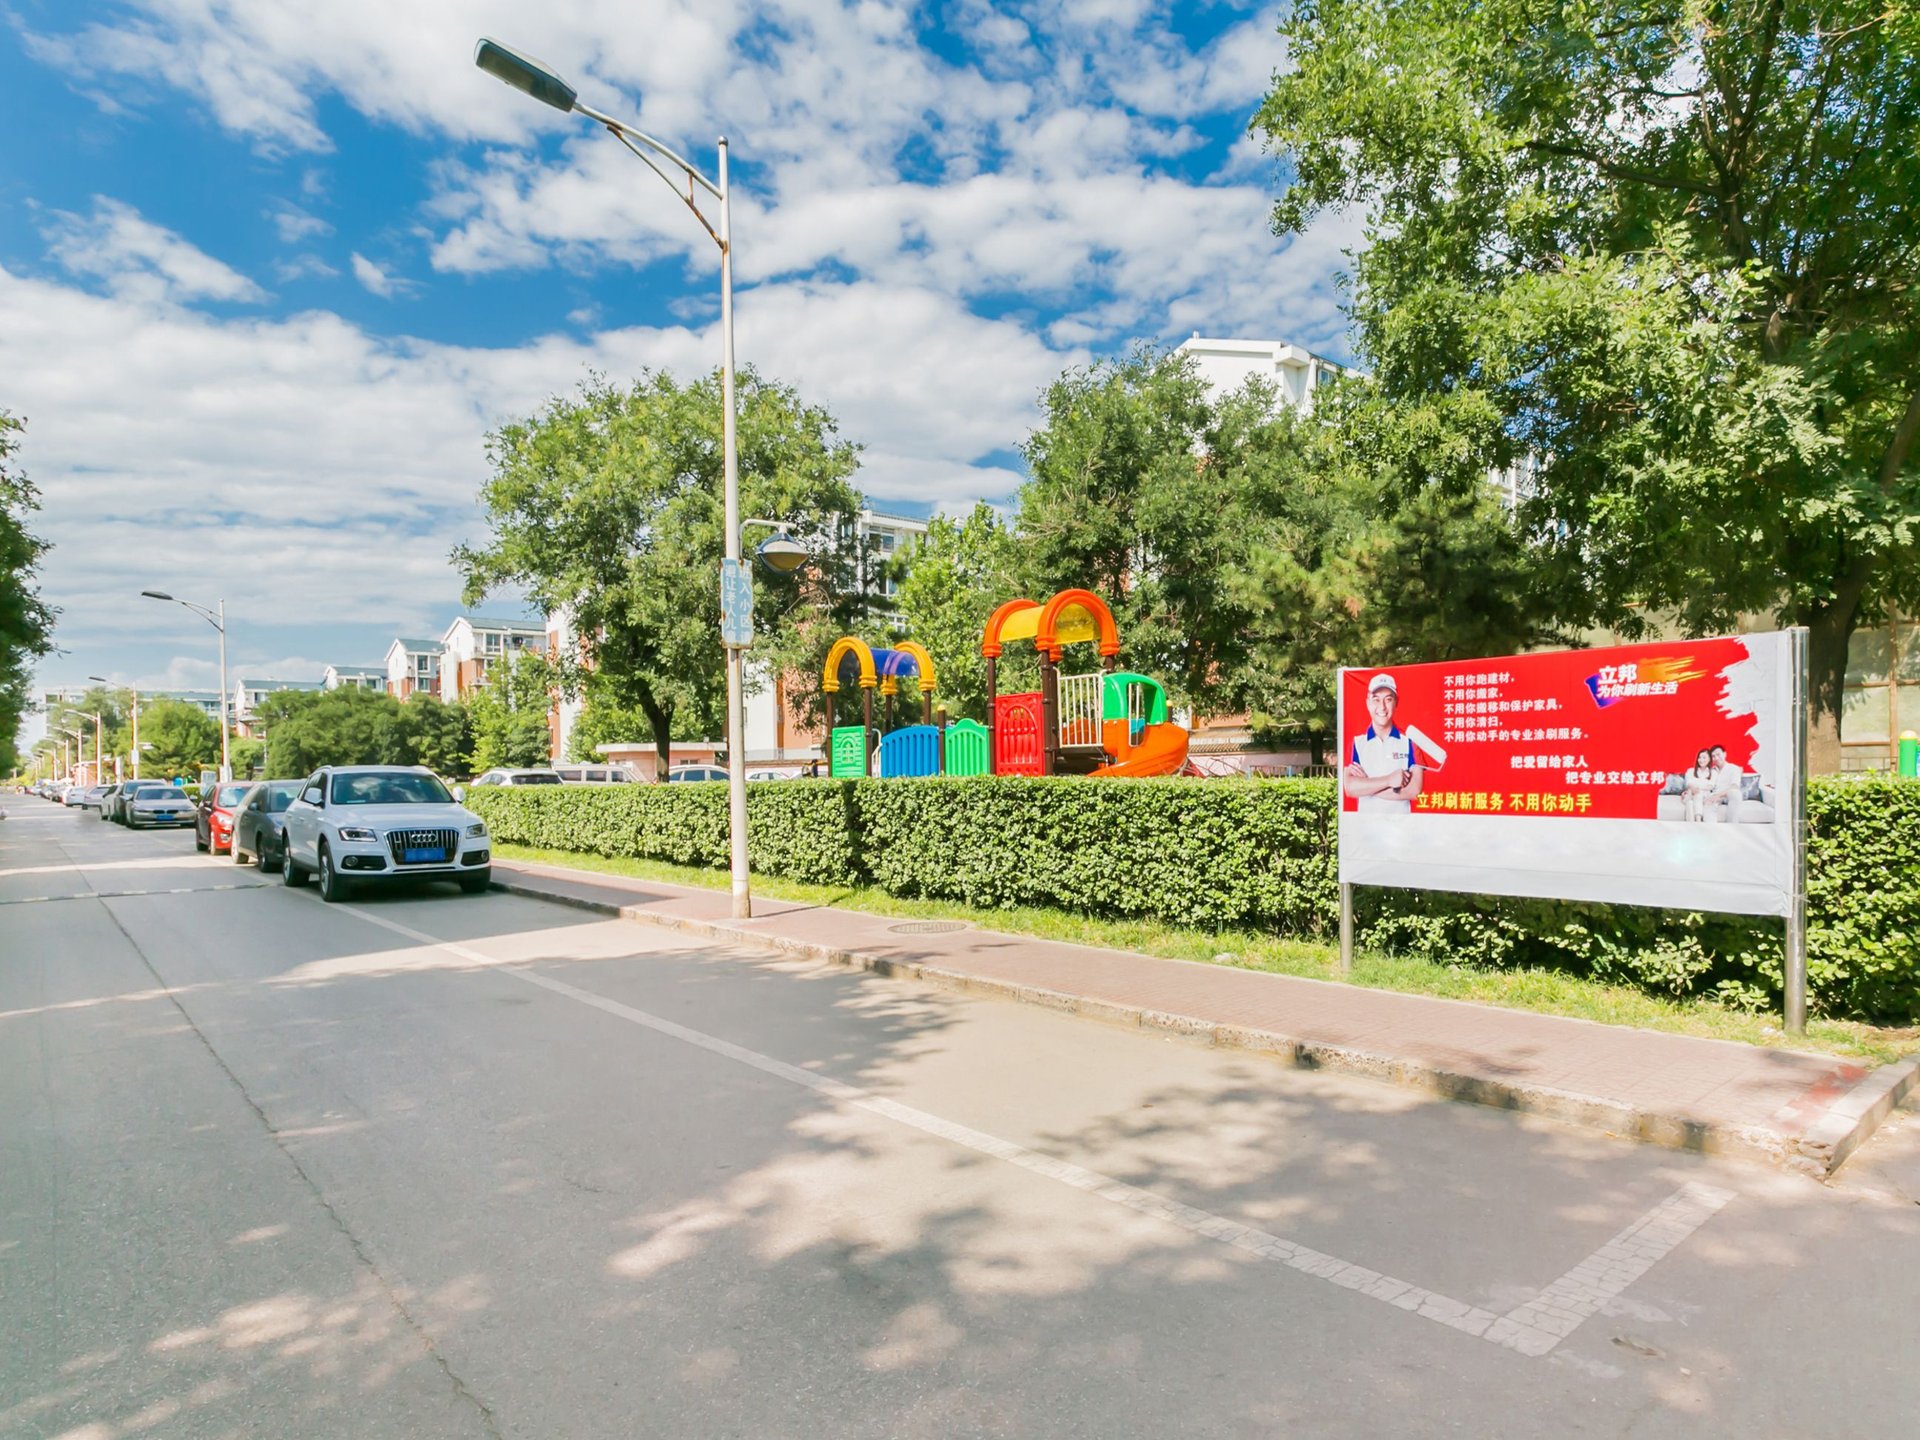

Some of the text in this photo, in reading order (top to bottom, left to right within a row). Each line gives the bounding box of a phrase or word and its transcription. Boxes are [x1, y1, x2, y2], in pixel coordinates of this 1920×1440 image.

[725, 565, 737, 643] 让老人儿
[739, 561, 752, 643] 入小区
[1598, 664, 1638, 684] 立邦
[1597, 681, 1679, 698] 为你刷新生活
[1510, 755, 1589, 769] 把爱留给家人
[1565, 770, 1665, 785] 把专业交给立邦
[1416, 791, 1592, 813] 立邦刷新服务 不用你动手
